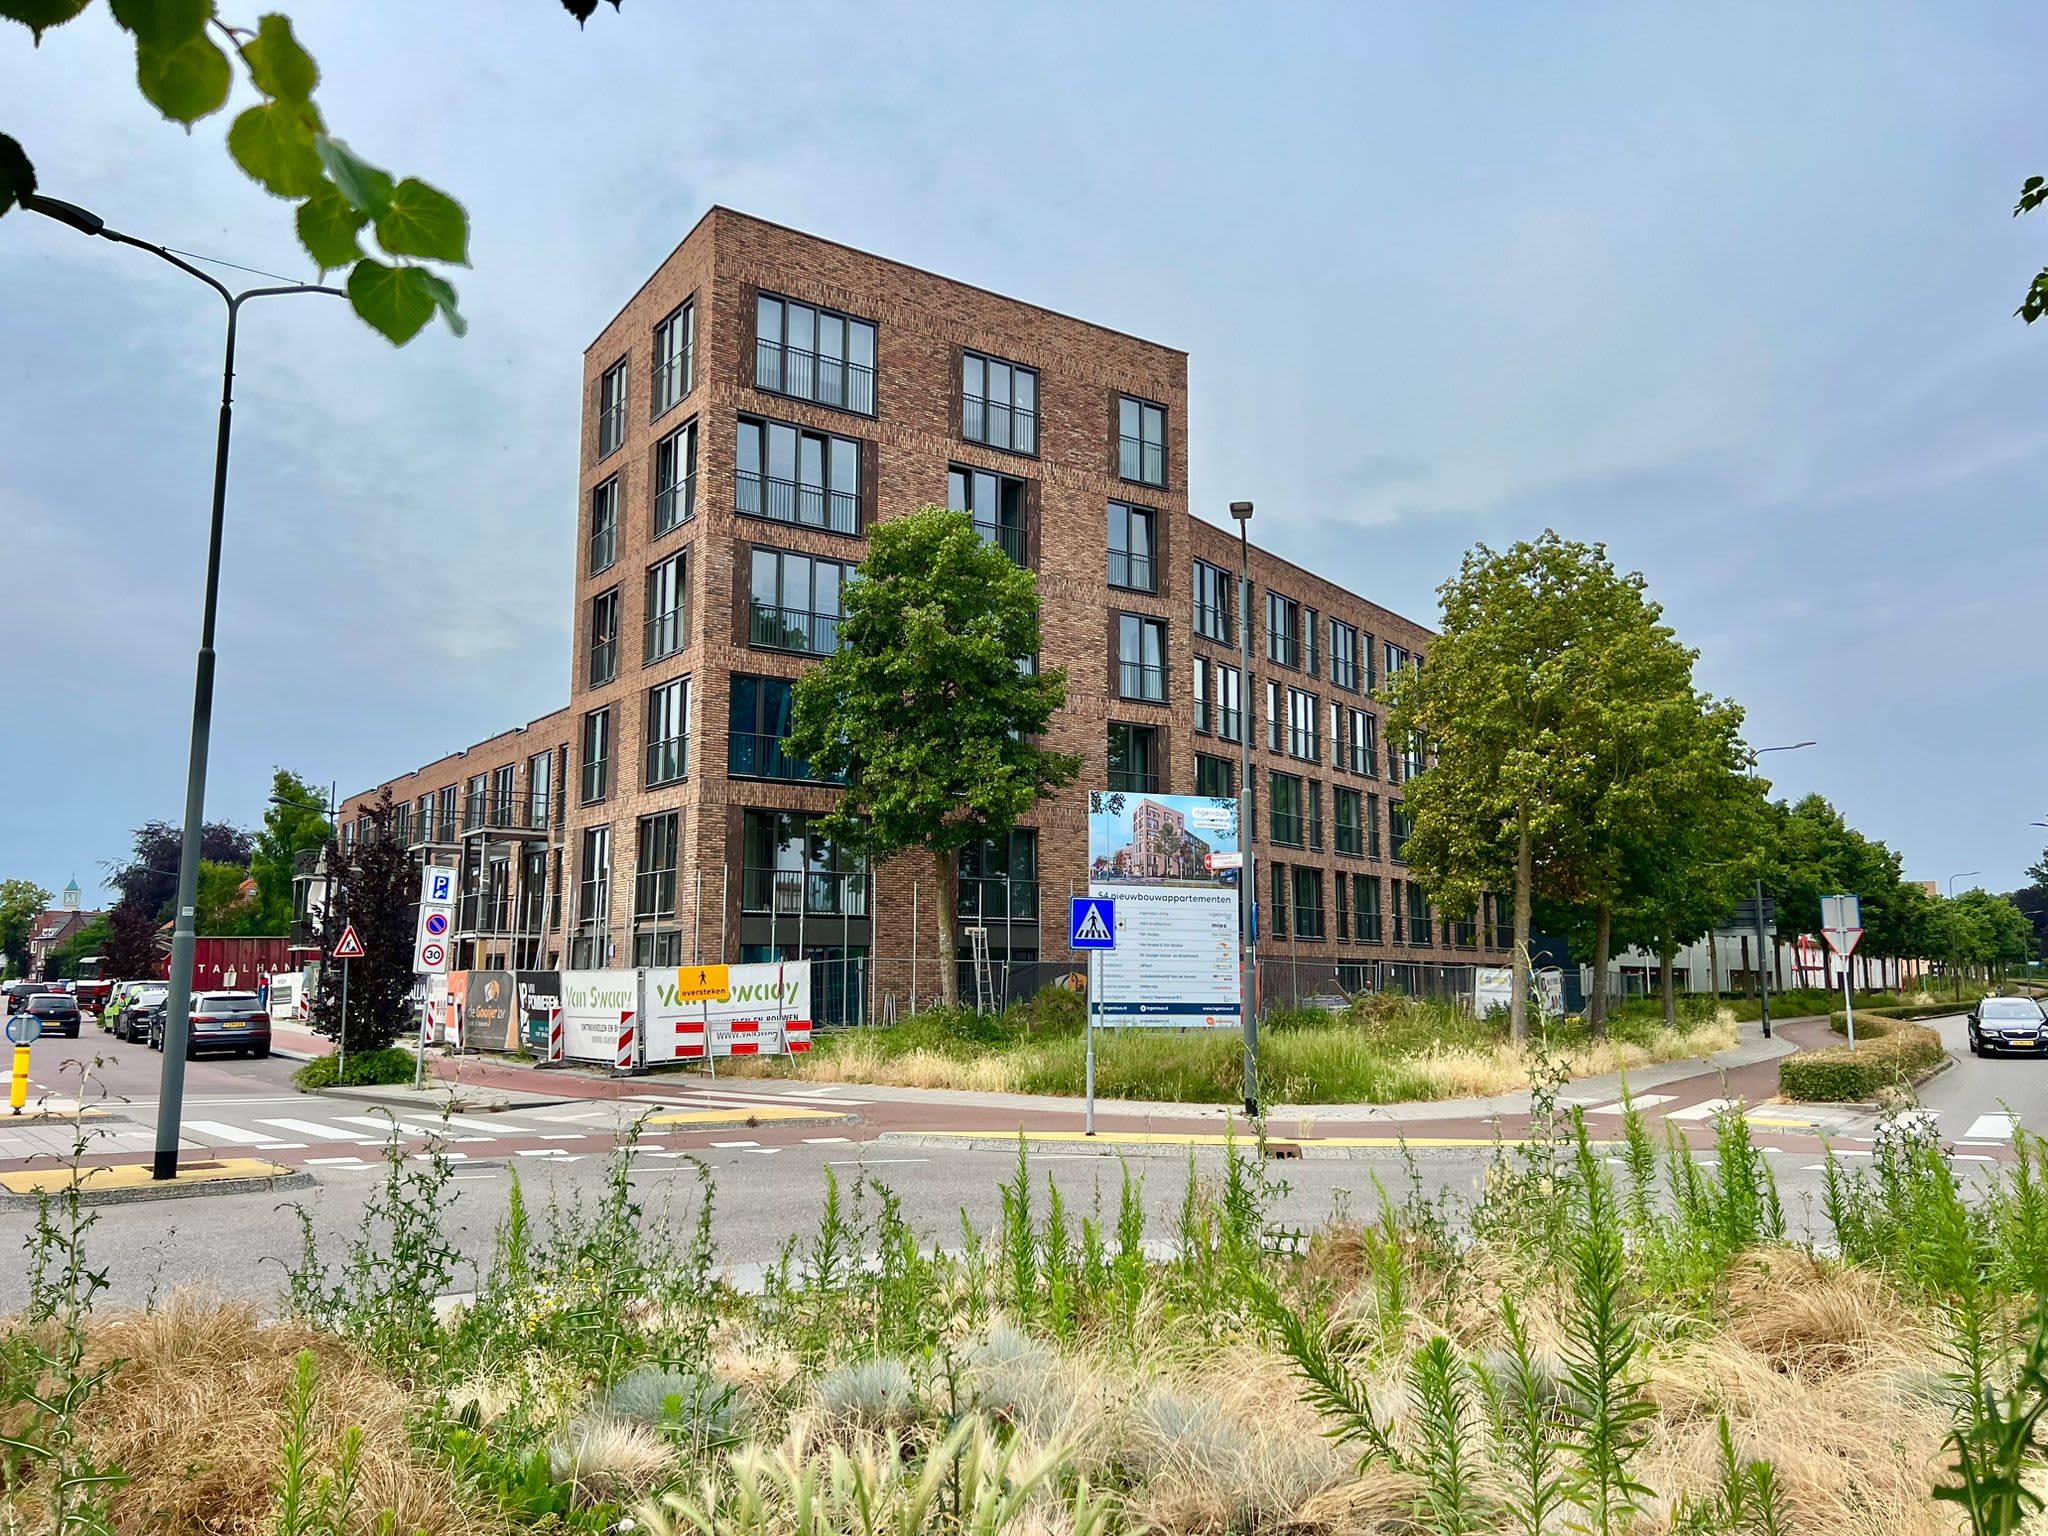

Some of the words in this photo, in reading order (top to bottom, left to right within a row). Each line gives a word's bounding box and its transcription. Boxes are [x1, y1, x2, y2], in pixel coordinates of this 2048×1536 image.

[1194, 809, 1228, 818] ingenious
[436, 877, 447, 890] P
[1098, 891, 1110, 900] 54
[1111, 892, 1232, 904] nieuwbouwappartementen
[426, 950, 441, 960] 30
[565, 985, 587, 1008] Van
[590, 985, 632, 1008] Swaay
[681, 988, 727, 997] oversteken
[467, 1006, 475, 1018] de
